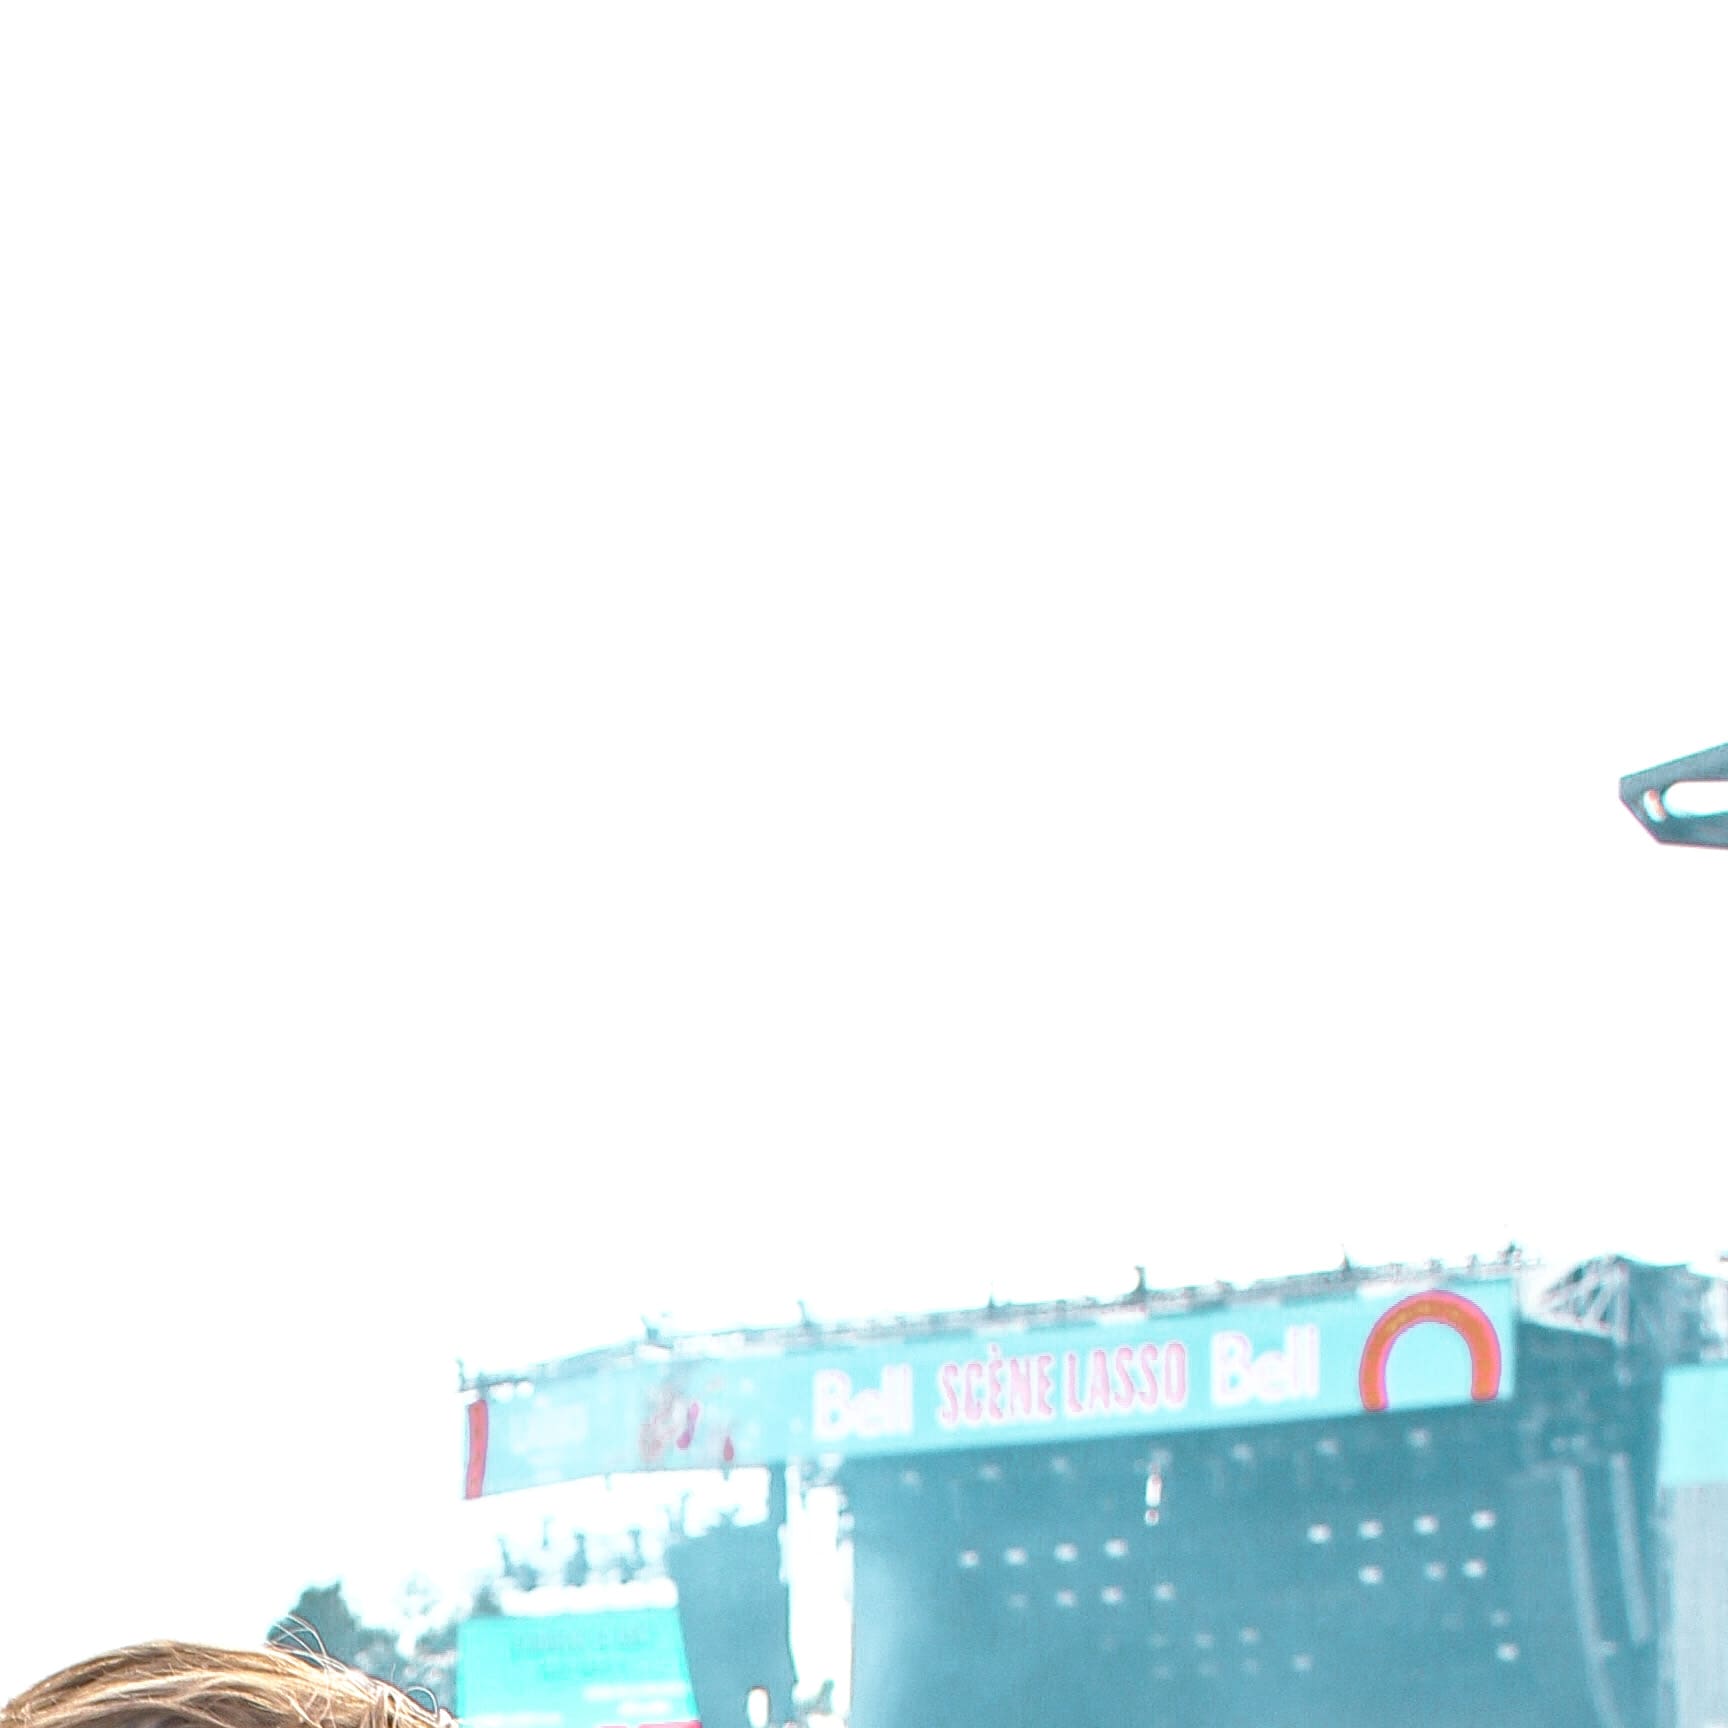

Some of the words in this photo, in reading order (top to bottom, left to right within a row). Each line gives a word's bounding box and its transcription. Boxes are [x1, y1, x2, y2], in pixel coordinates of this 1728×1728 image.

[814, 1364, 912, 1437] Bell
[939, 1343, 1054, 1426] SCÈNE
[1065, 1340, 1188, 1415] LASSO
[1212, 1325, 1320, 1403] Bell
